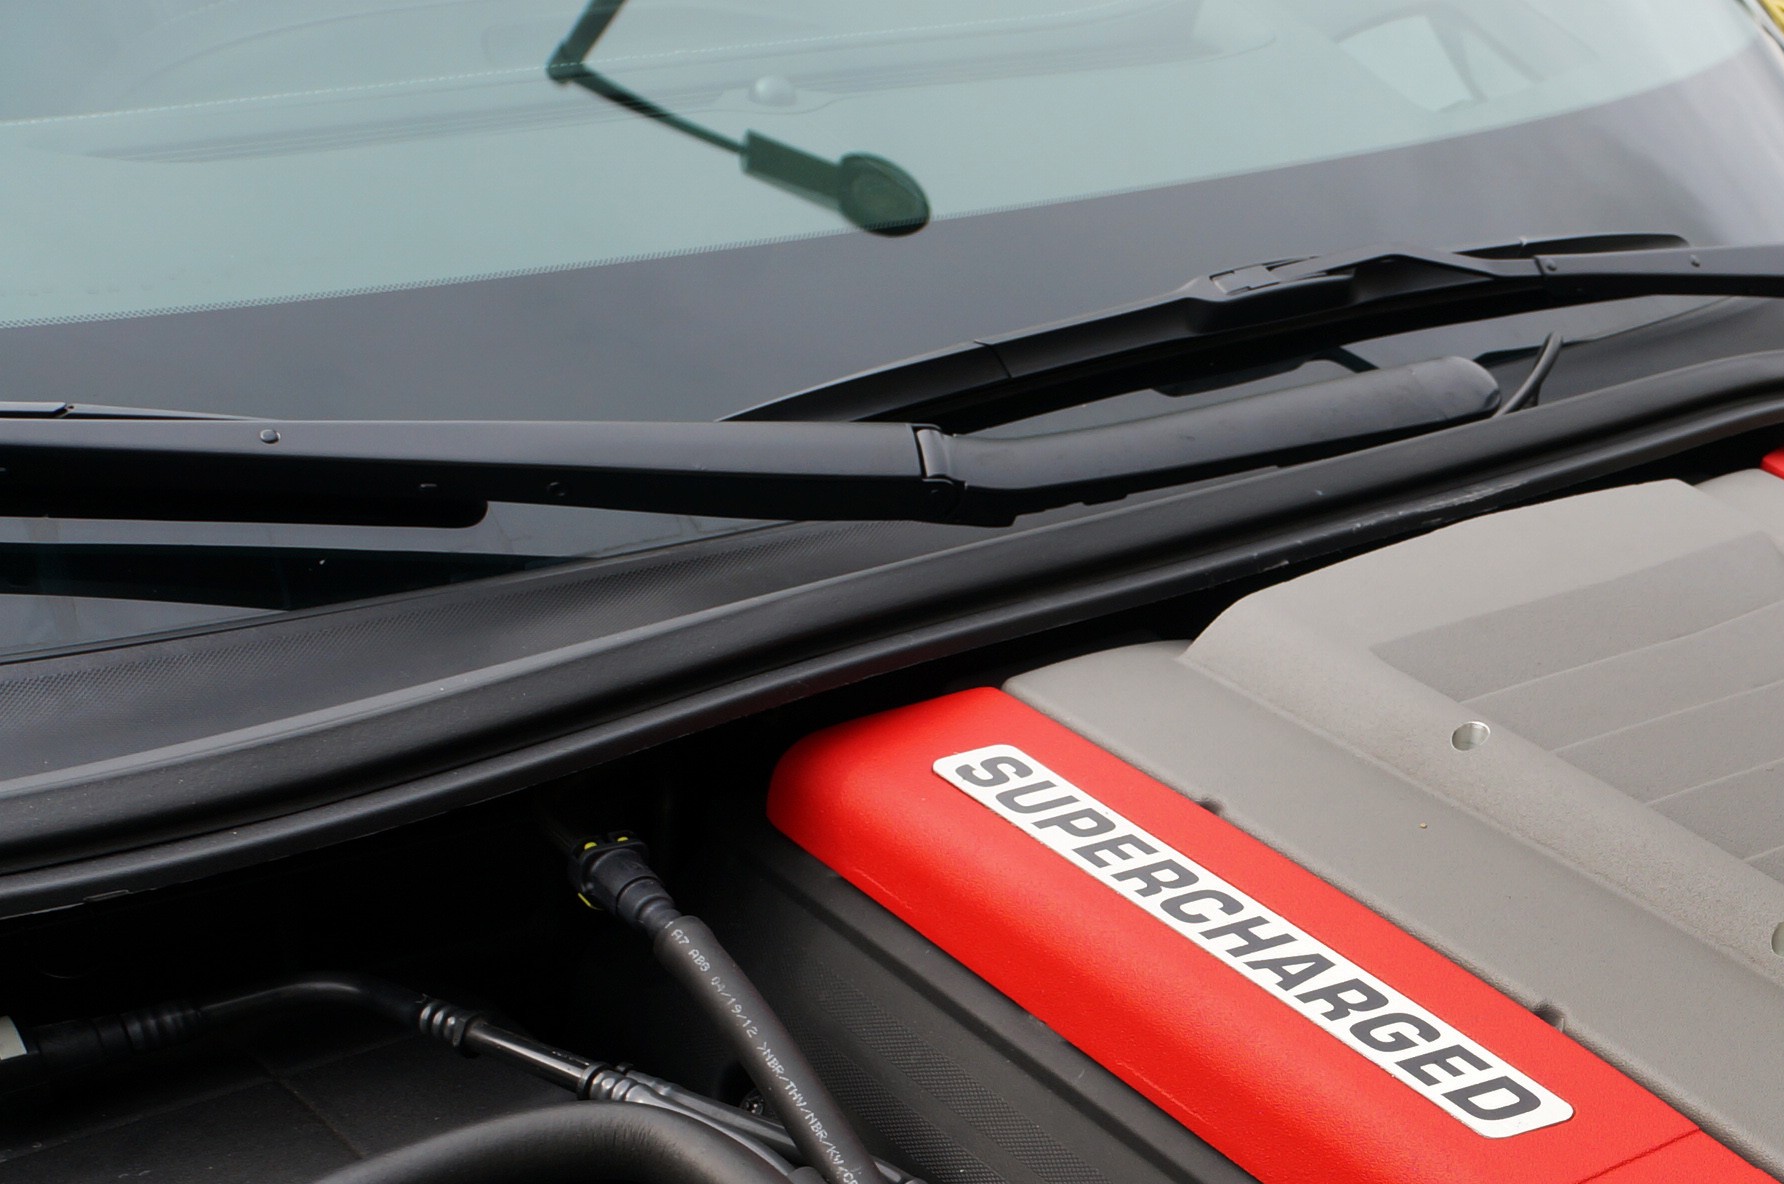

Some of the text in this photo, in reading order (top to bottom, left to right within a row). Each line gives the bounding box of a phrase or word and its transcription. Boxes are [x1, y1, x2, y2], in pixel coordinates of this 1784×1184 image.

[671, 929, 690, 945] A7
[711, 976, 759, 1038] 04/19/12
[955, 755, 1541, 1121] SUPERCHARGED
